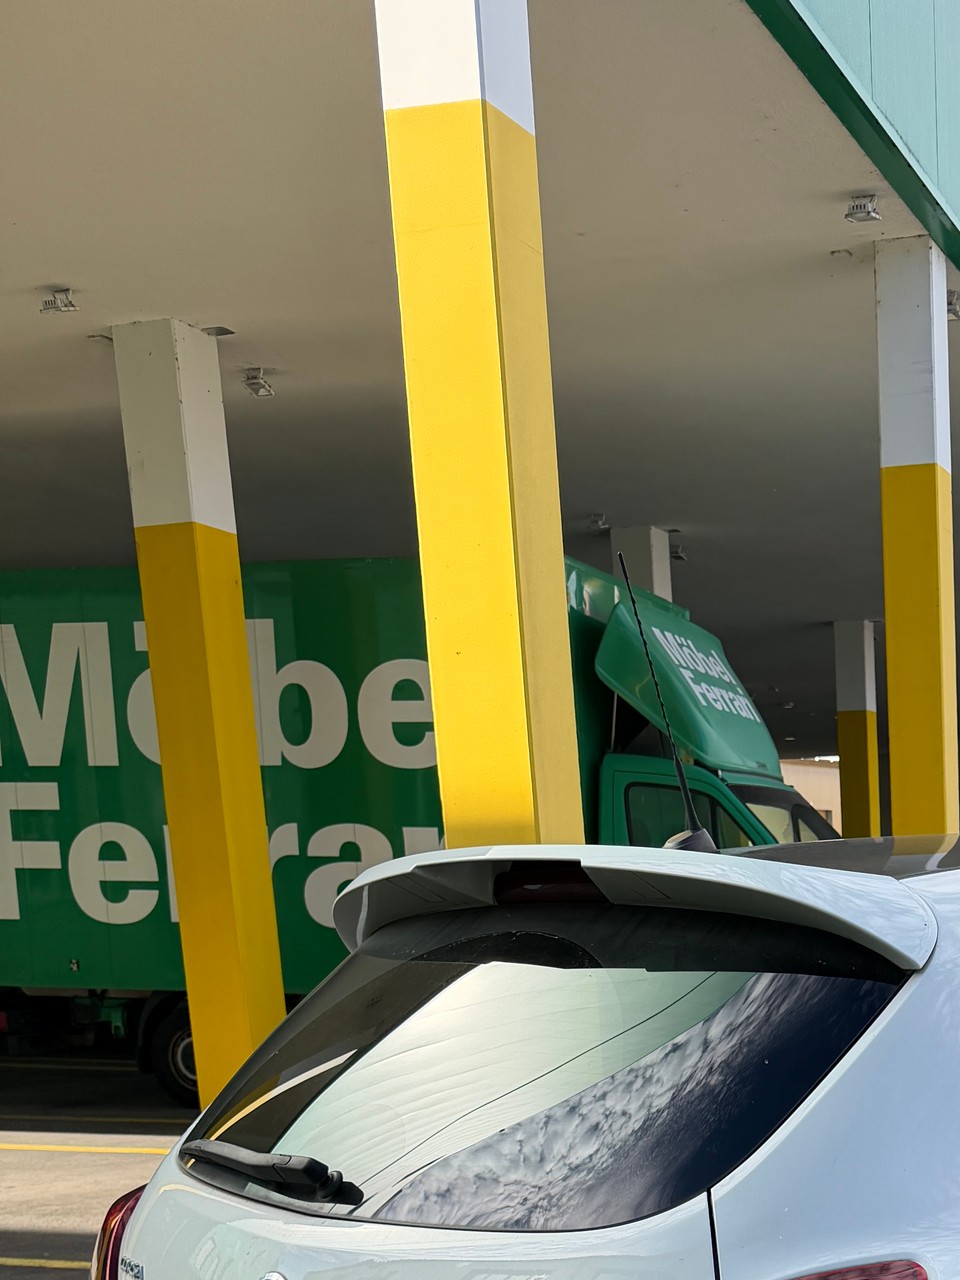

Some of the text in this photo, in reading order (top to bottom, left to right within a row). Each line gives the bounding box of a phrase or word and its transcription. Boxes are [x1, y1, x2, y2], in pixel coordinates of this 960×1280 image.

[651, 626, 737, 685] Möbel
[0, 618, 437, 769] Mbe
[680, 667, 761, 723] Ferrari
